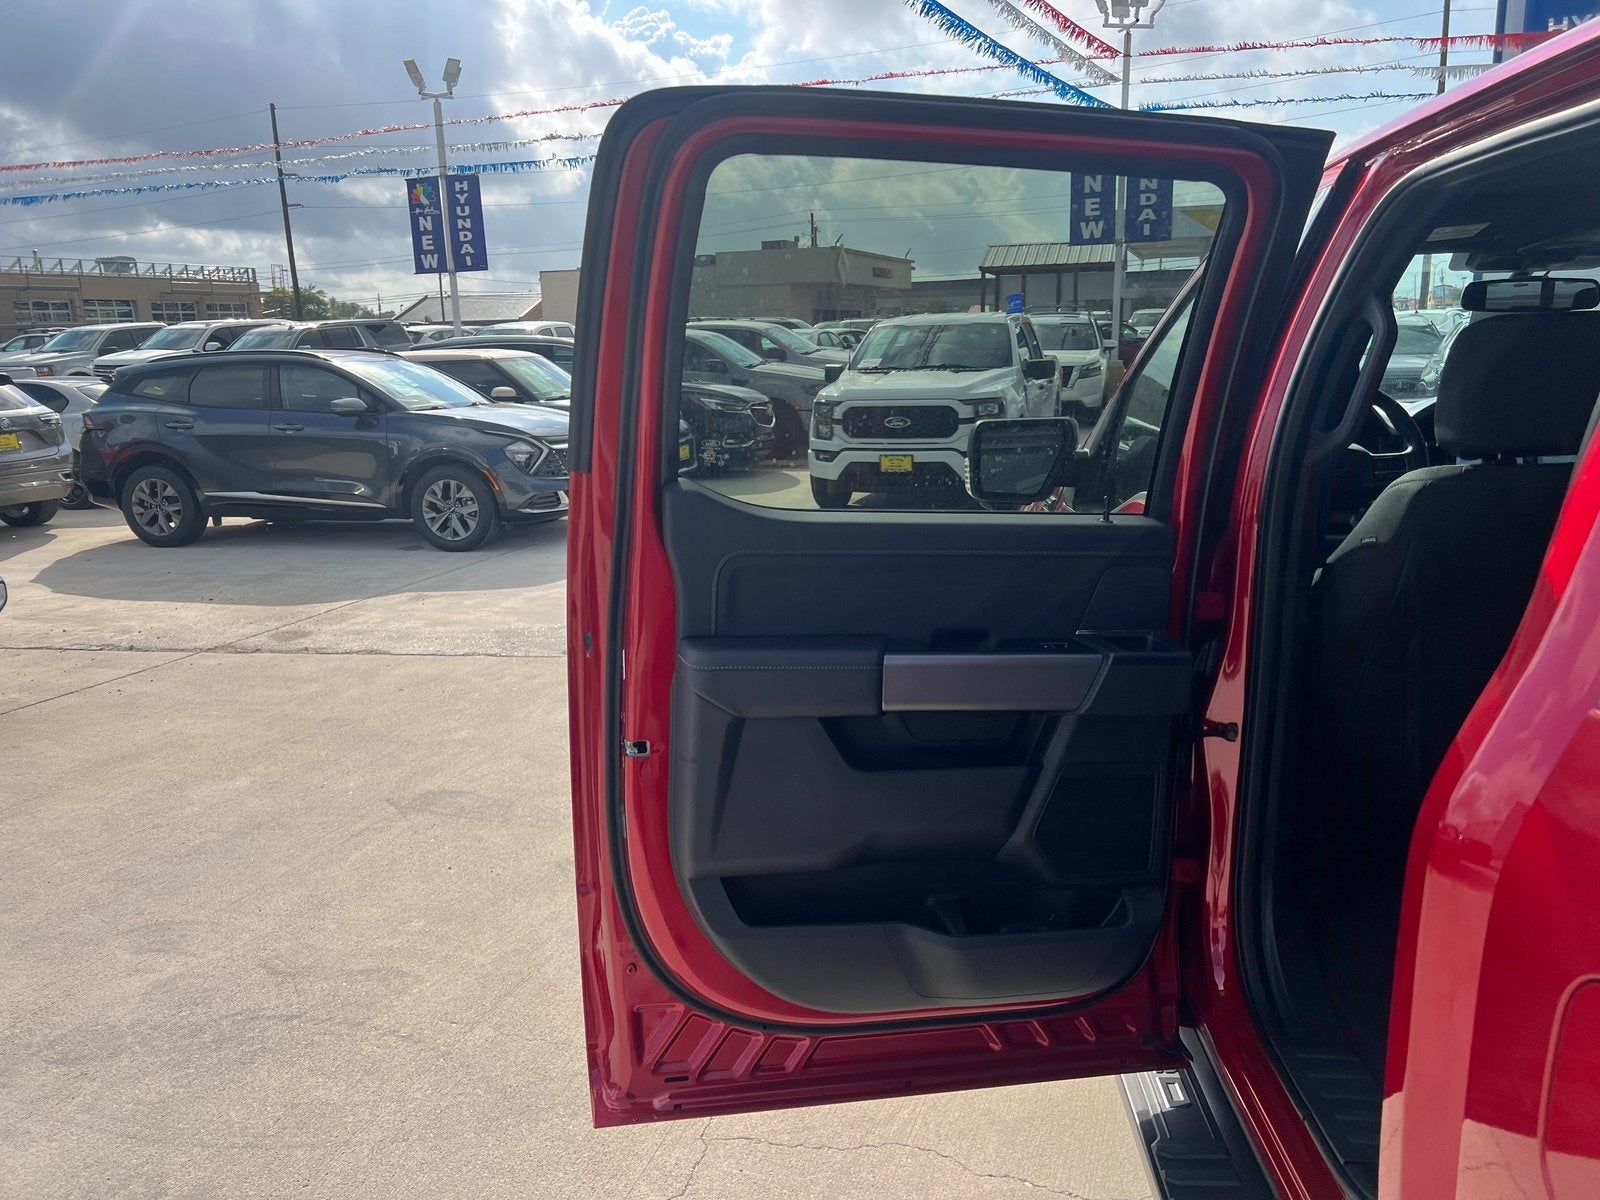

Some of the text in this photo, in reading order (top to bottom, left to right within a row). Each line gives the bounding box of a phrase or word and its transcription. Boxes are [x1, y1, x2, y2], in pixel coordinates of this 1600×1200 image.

[1547, 13, 1600, 32] HY
[455, 181, 475, 266] HYUNDAI
[1080, 175, 1104, 240] NEW
[1138, 178, 1159, 236] NDAI
[419, 216, 438, 269] NEW
